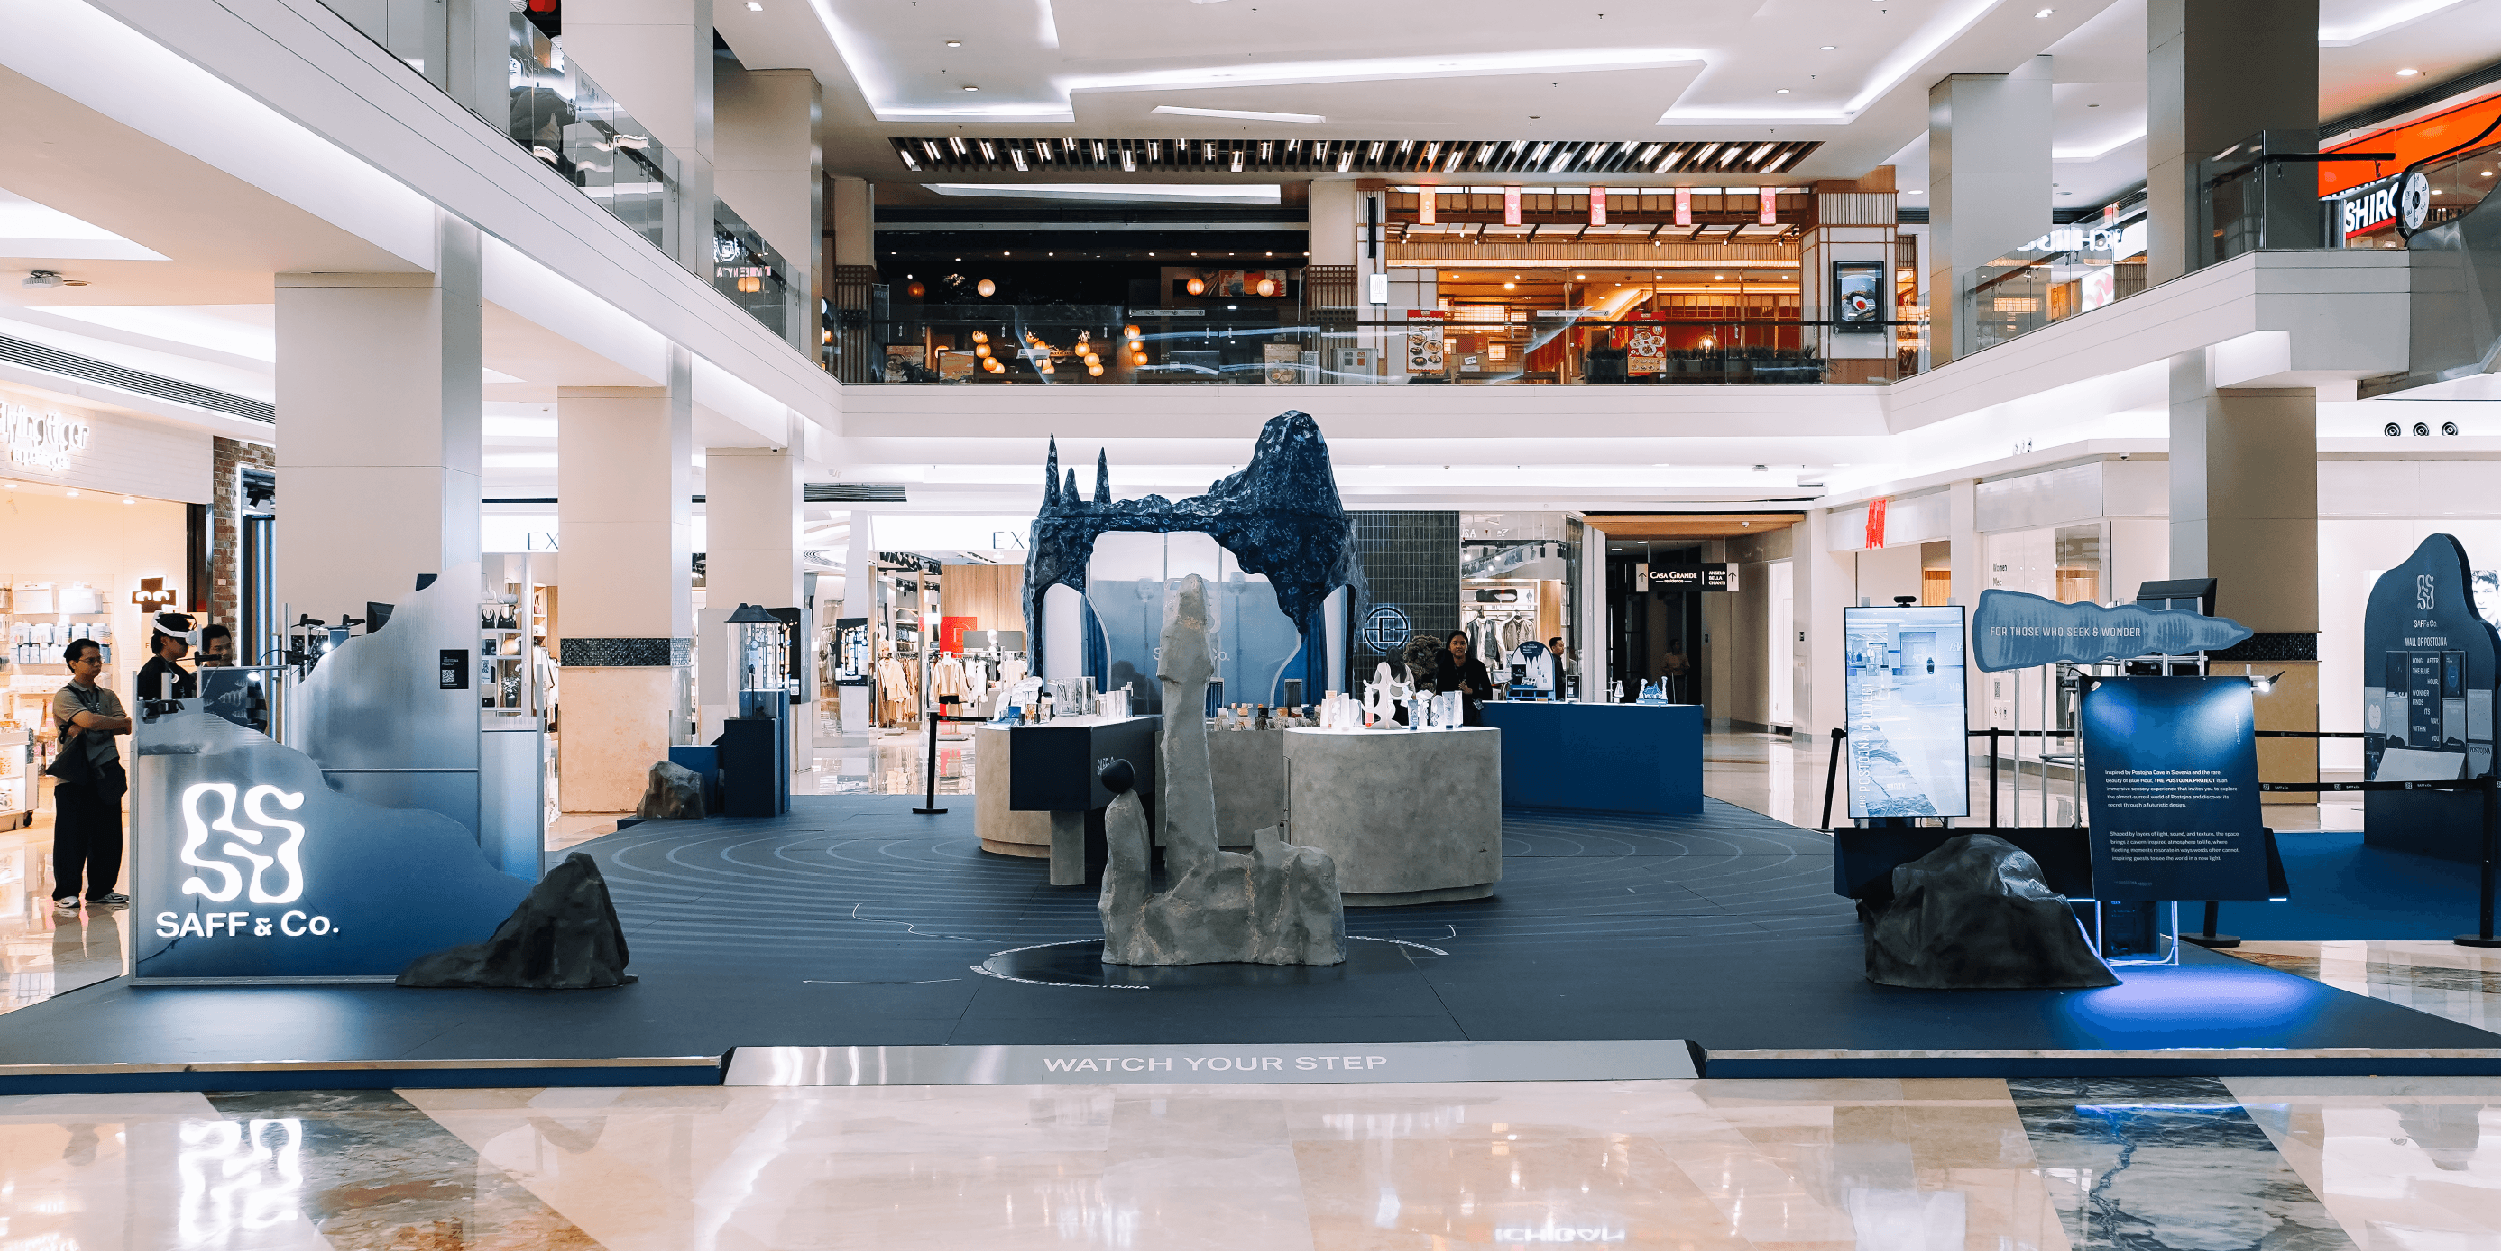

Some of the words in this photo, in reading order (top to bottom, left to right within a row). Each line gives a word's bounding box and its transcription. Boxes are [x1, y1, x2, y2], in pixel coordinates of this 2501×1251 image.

[0, 402, 44, 448] lying
[1991, 626, 2007, 637] FOR
[2010, 626, 2039, 637] THOSE
[2042, 626, 2064, 637] WHO
[2066, 626, 2090, 637] SEEK
[2092, 626, 2098, 637] &
[2101, 626, 2141, 637] WONDER
[156, 912, 250, 938] SAFF
[254, 918, 273, 938] &
[280, 910, 339, 937] Co.
[1044, 1057, 1173, 1073] WATCH
[1184, 1057, 1285, 1072] YOUR
[1295, 1056, 1388, 1071] STEP
